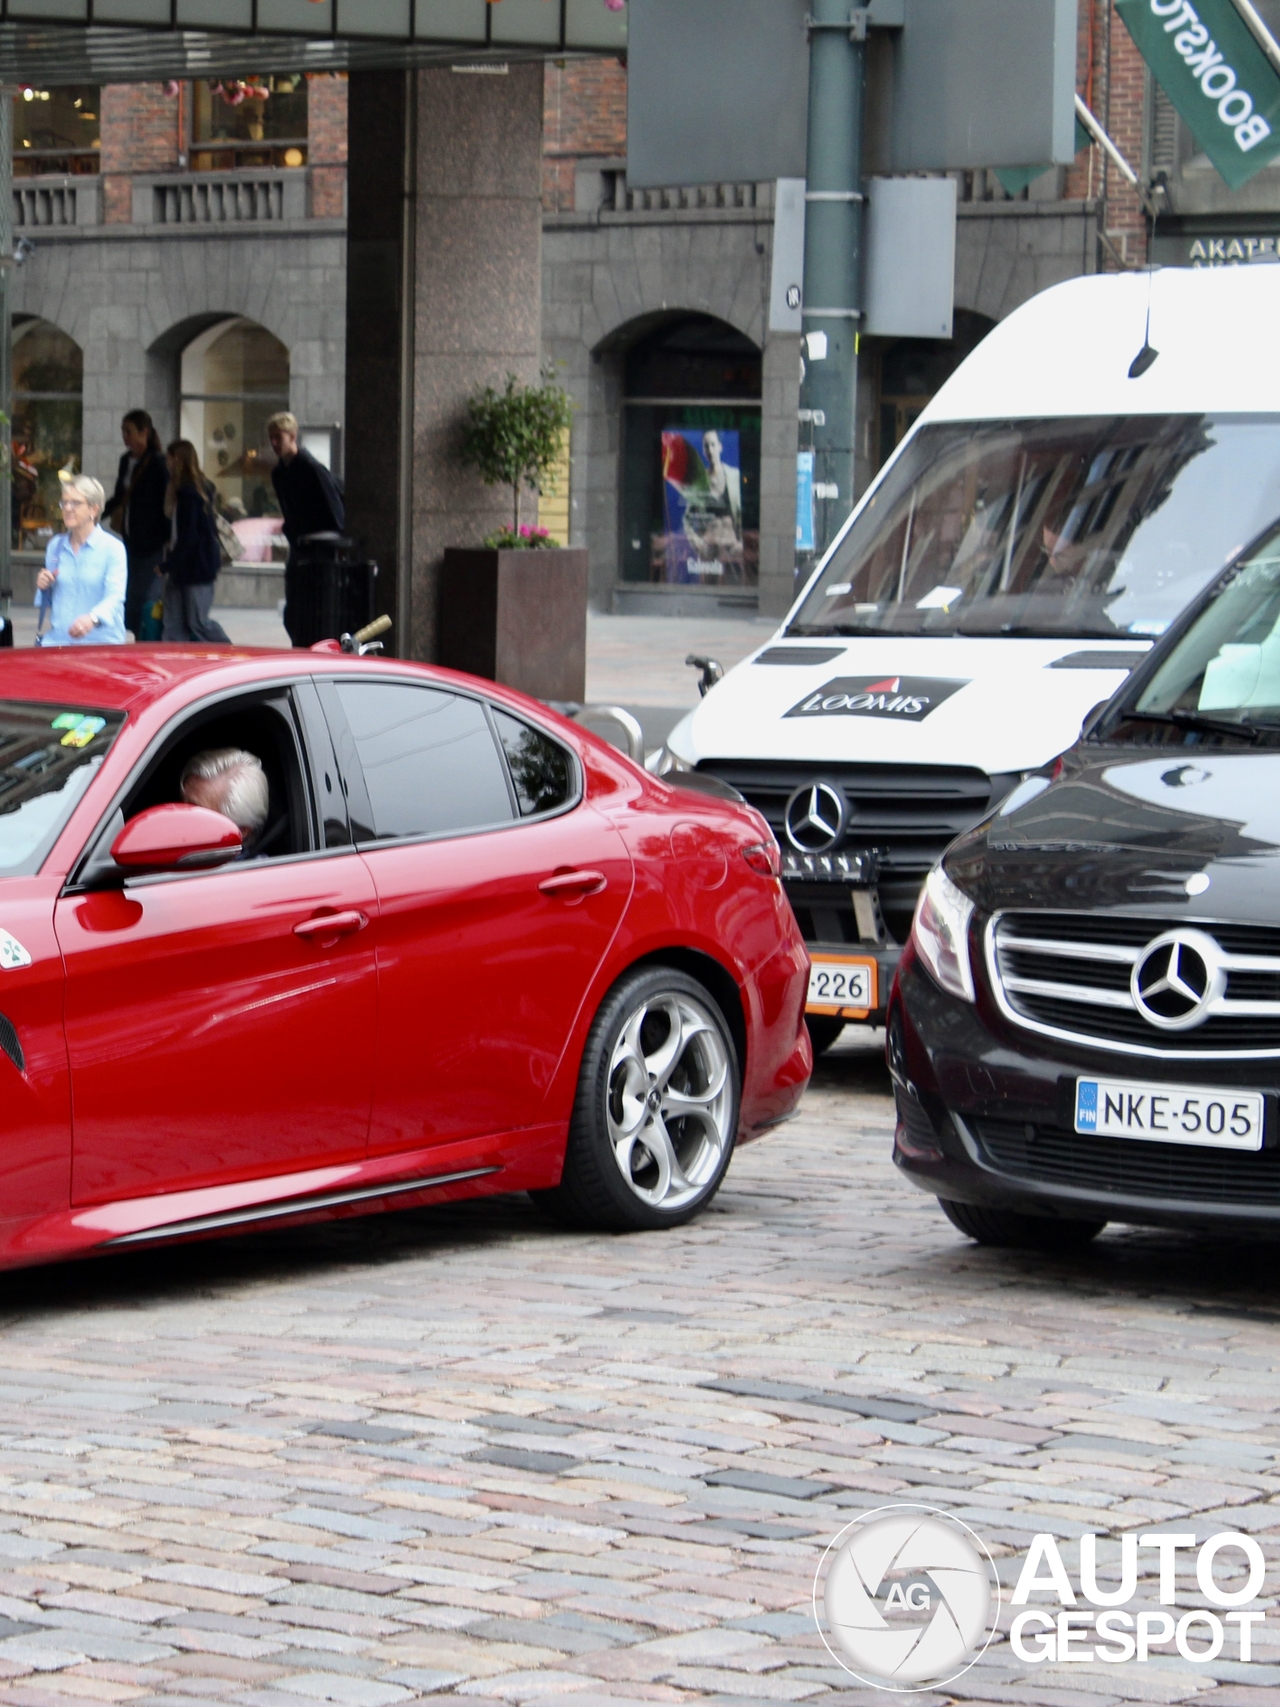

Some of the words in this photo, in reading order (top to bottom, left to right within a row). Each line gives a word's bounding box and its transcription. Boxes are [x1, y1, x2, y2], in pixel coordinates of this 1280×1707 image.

[1189, 238, 1280, 259] AKATE
[801, 693, 930, 713] LOOMIS
[1079, 1109, 1096, 1123] FIN
[1104, 1091, 1252, 1136] NKE-505
